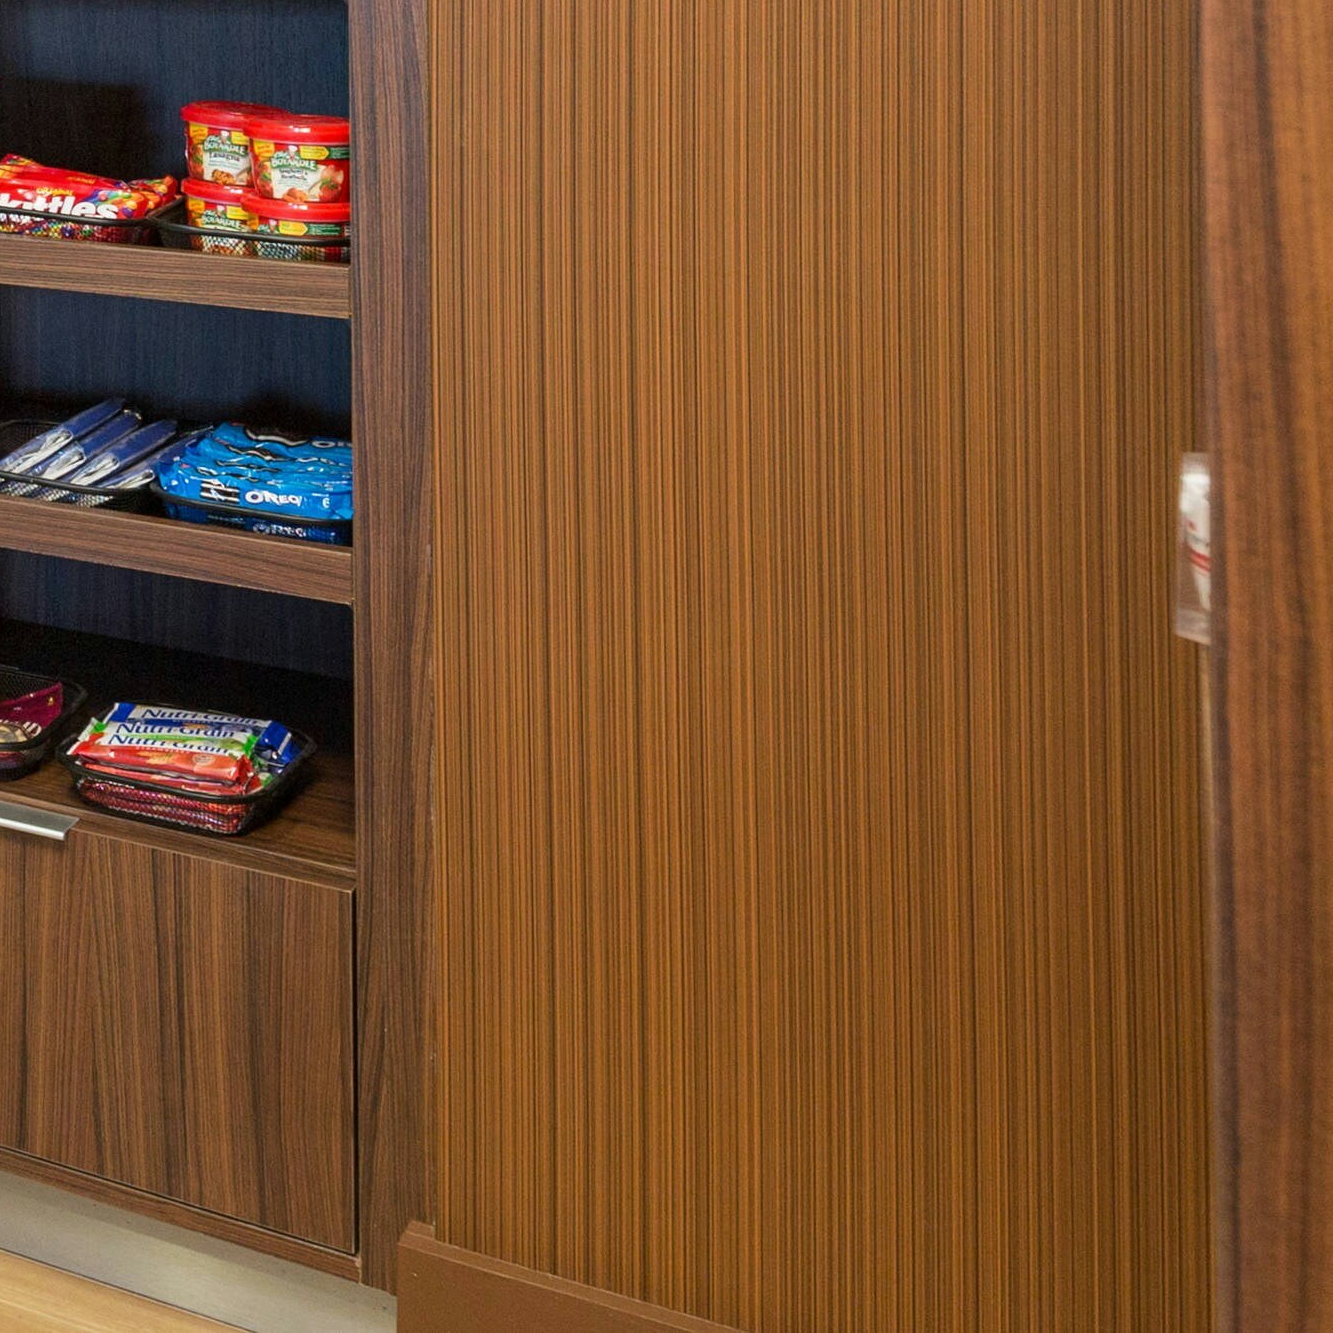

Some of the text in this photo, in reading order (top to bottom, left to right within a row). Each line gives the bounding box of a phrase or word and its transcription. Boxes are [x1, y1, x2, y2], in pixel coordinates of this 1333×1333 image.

[271, 157, 318, 170] BOYARDEE
[244, 490, 302, 508] OREO
[141, 708, 259, 725] Nutri-Grain
[116, 723, 235, 738] Nutri-Grain
